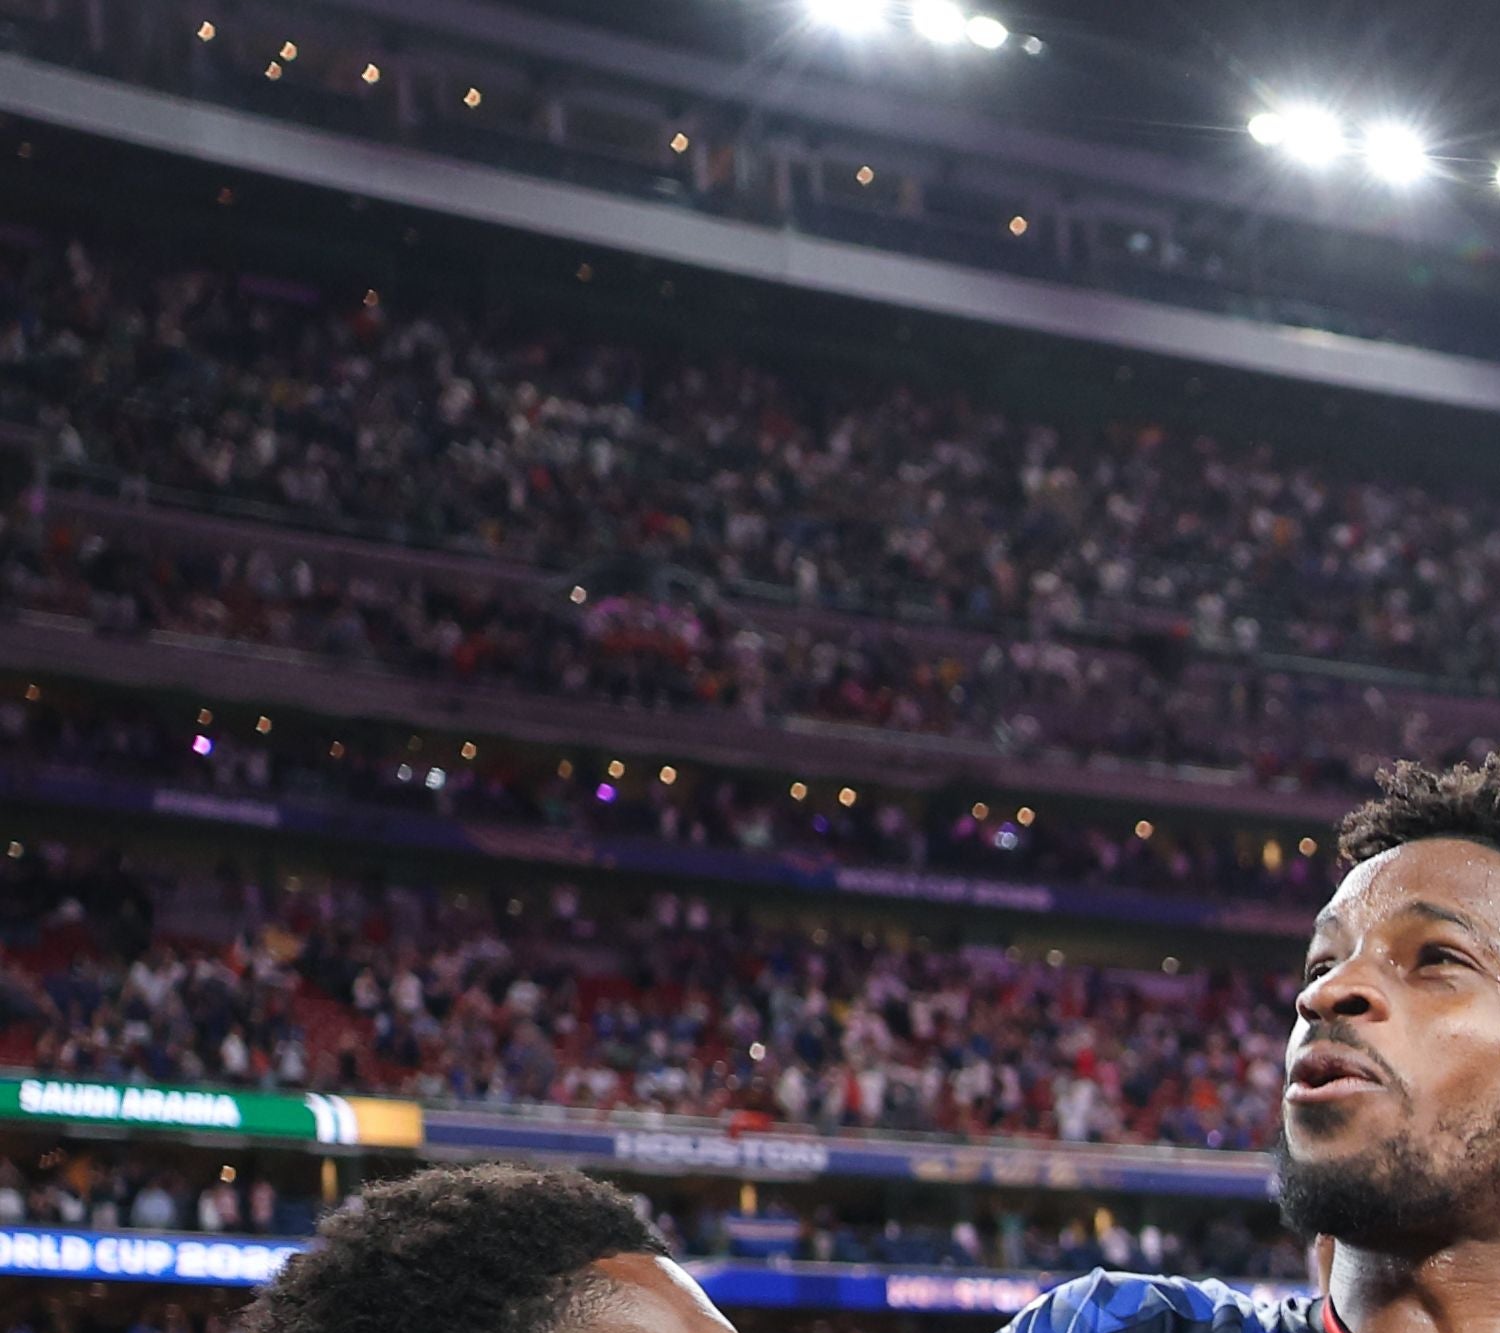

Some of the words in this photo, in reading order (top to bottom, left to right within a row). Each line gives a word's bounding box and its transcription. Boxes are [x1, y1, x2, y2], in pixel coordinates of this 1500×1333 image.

[19, 1079, 119, 1119] SAUDI
[121, 1087, 242, 1129] ARABIA
[615, 1130, 829, 1172] HOUSTON
[94, 1237, 175, 1276] CUP
